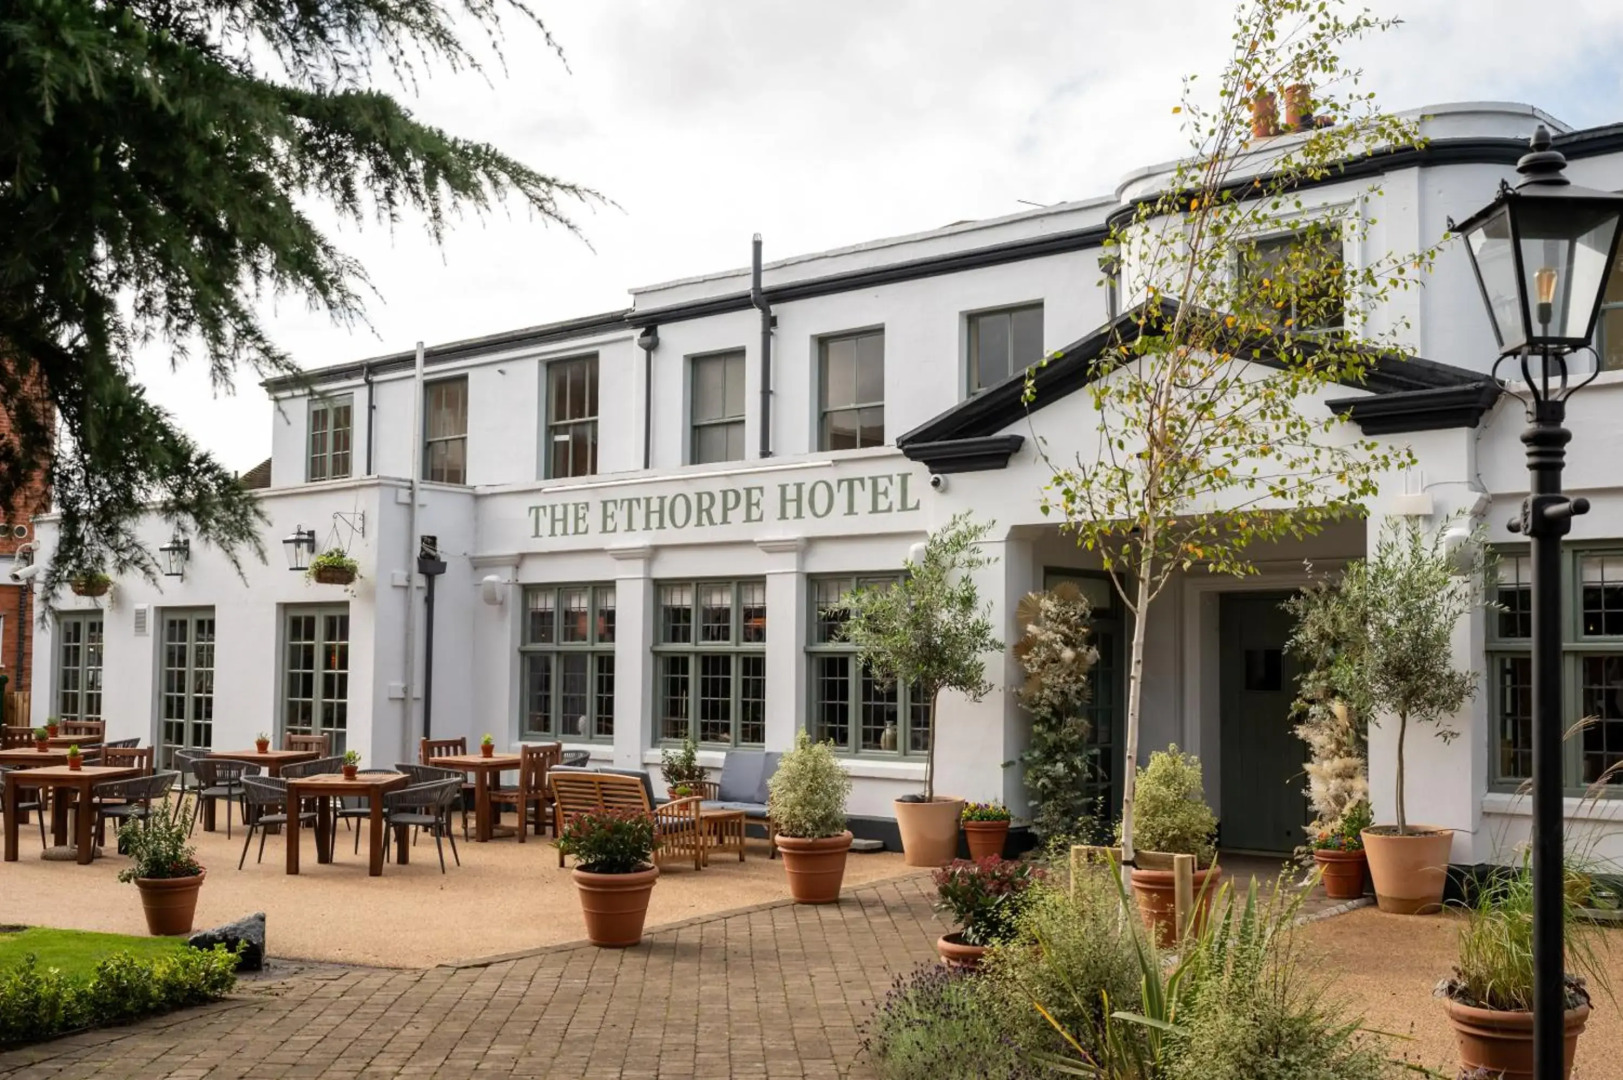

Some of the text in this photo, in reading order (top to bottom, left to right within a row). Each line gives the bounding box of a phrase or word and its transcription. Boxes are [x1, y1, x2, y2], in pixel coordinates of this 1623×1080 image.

[528, 472, 921, 538] THE ETHORPE HOTEL
